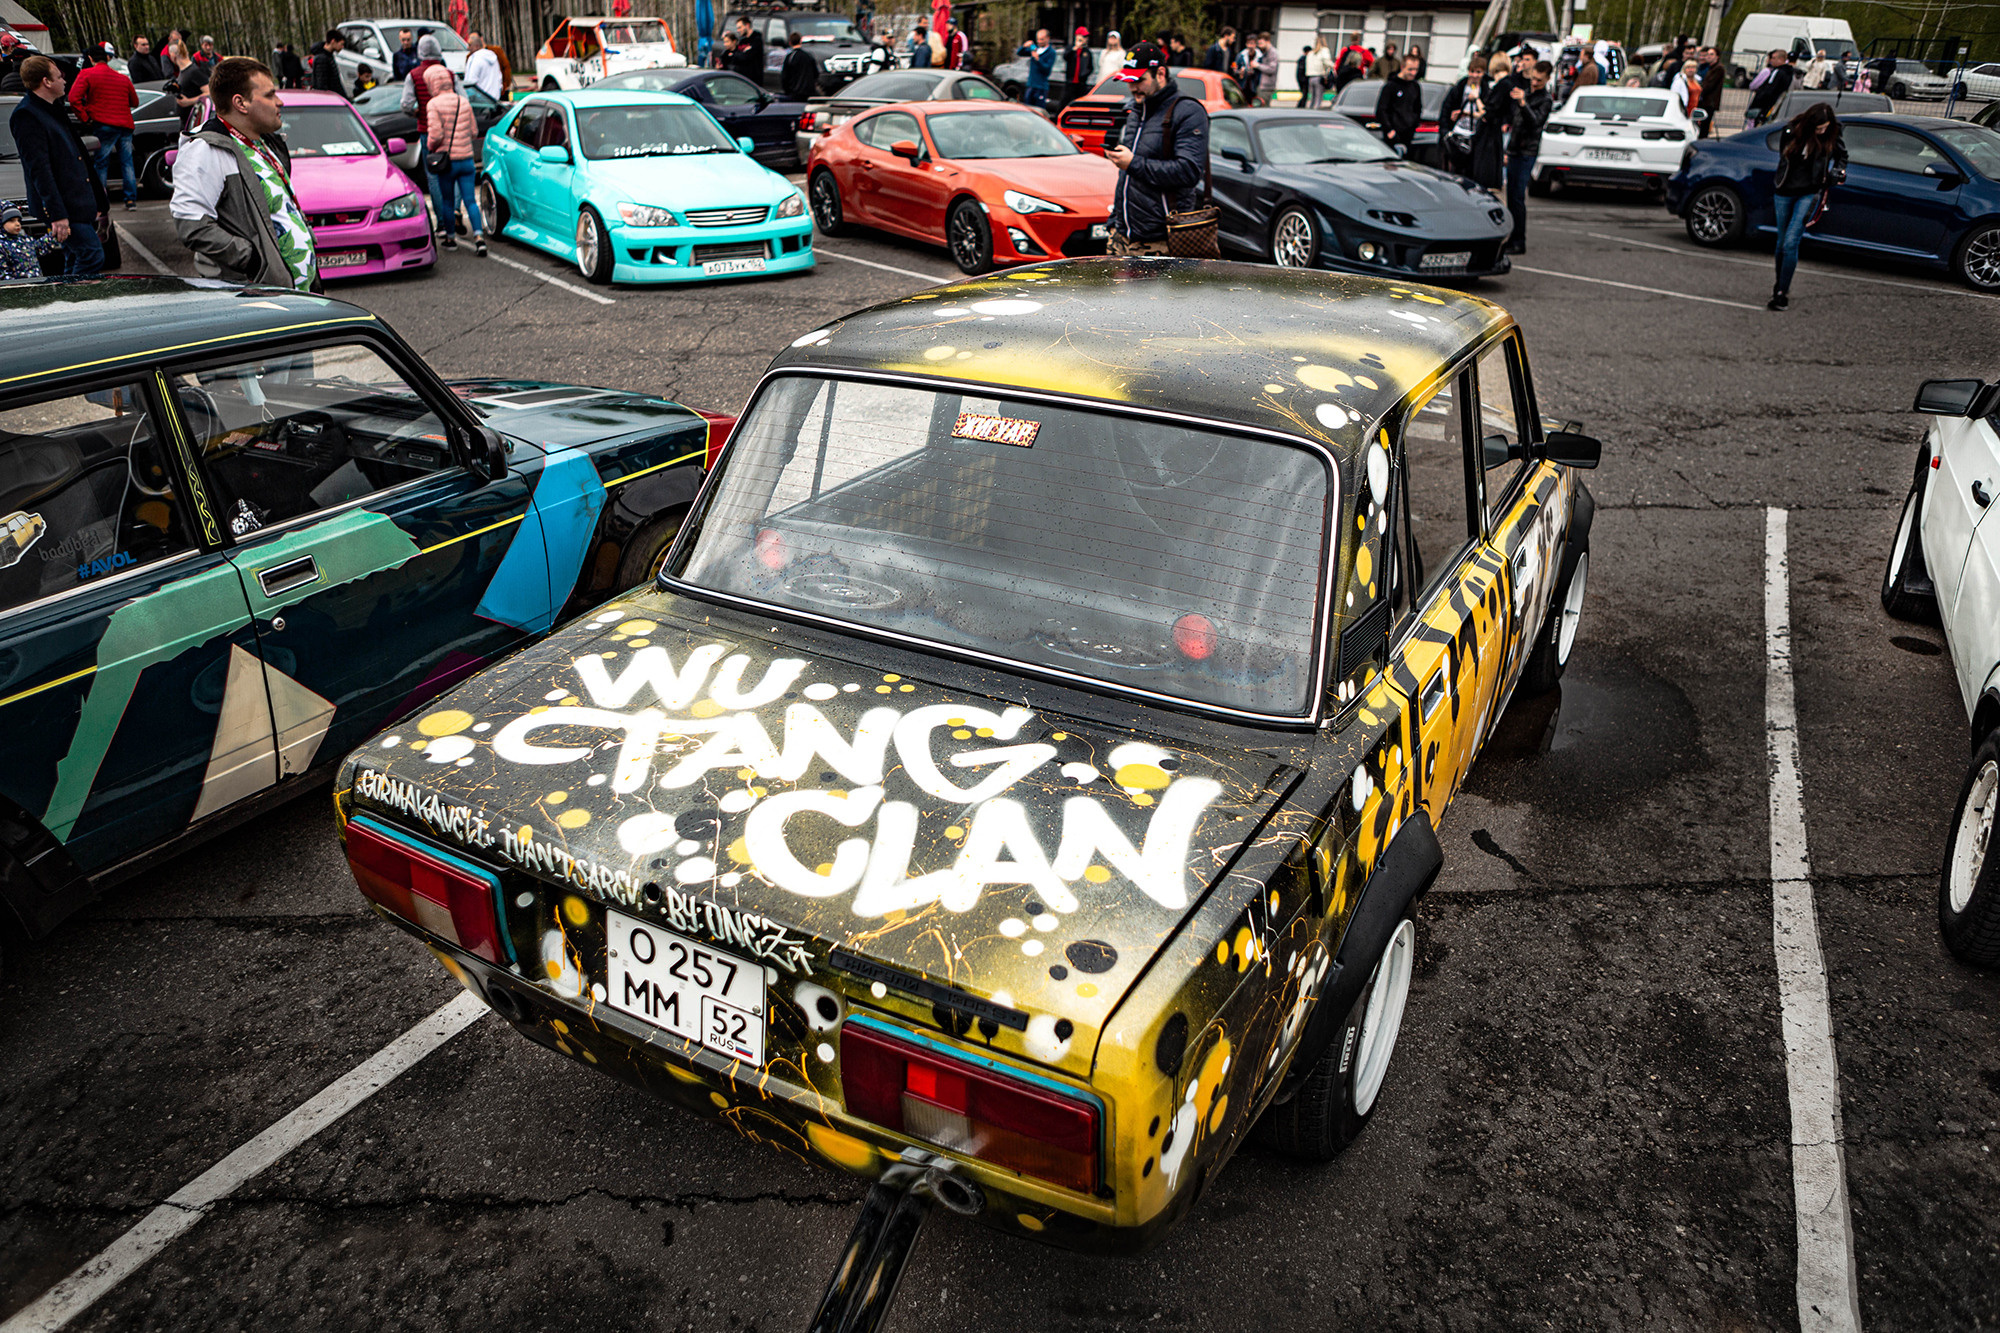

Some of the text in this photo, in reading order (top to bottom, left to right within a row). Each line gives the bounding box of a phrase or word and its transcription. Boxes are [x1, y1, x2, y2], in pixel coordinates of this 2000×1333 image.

[958, 416, 1034, 443] ЖИГУАР
[77, 551, 137, 579] #AVOL
[572, 643, 810, 711] WU
[493, 702, 1058, 805] TANG
[744, 775, 1225, 919] CLAN
[630, 926, 738, 996] O 257
[624, 970, 747, 1045] MM 52
[709, 1032, 735, 1051] RUS
